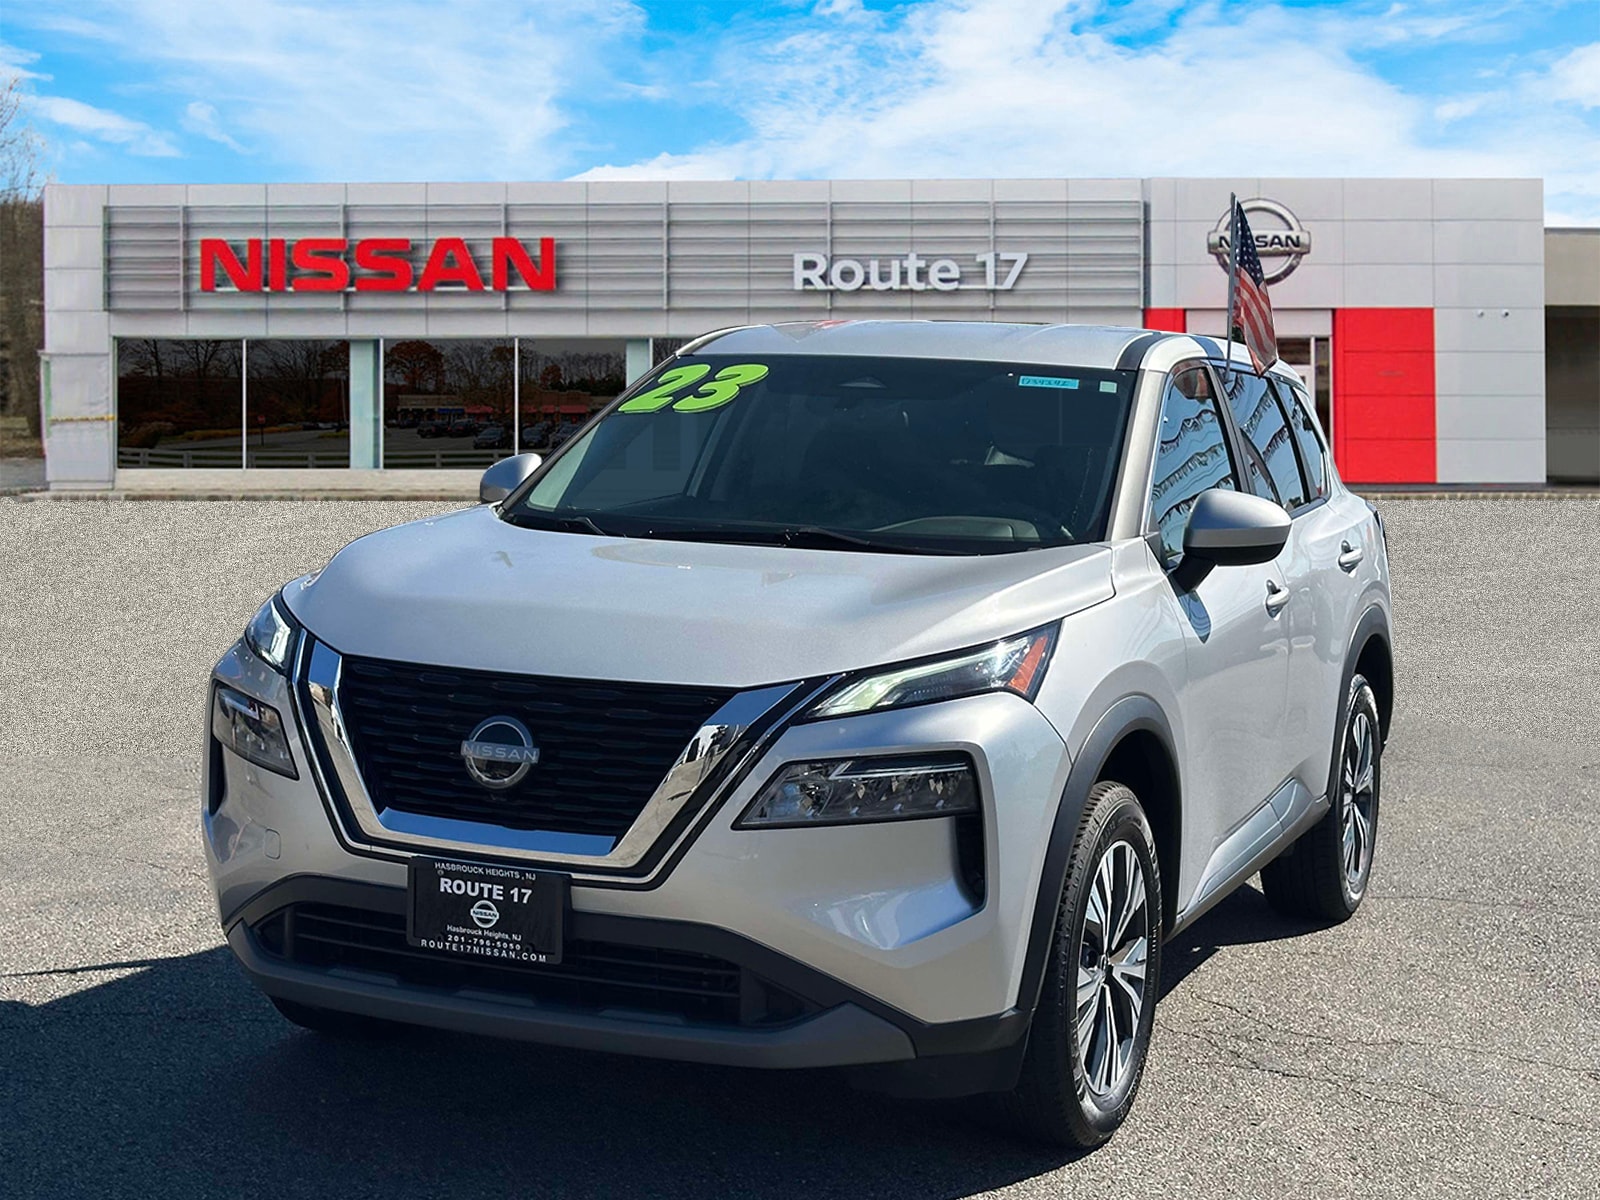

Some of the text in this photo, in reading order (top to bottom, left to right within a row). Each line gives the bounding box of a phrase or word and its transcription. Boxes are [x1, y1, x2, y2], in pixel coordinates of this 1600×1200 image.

[1219, 235, 1300, 248] NSAN
[200, 237, 555, 292] NISSAN
[793, 252, 1028, 291] Route 17
[618, 364, 769, 413] 23
[463, 744, 536, 760] NISSAN
[435, 862, 484, 874] HASBROUCK
[525, 872, 536, 880] NJ
[440, 877, 532, 904] ROUTE 17
[473, 910, 498, 918] NISSAN
[446, 924, 522, 941] Hasbrouck Heights, NJ
[421, 939, 546, 962] ROUTE17NISSAN.COM
